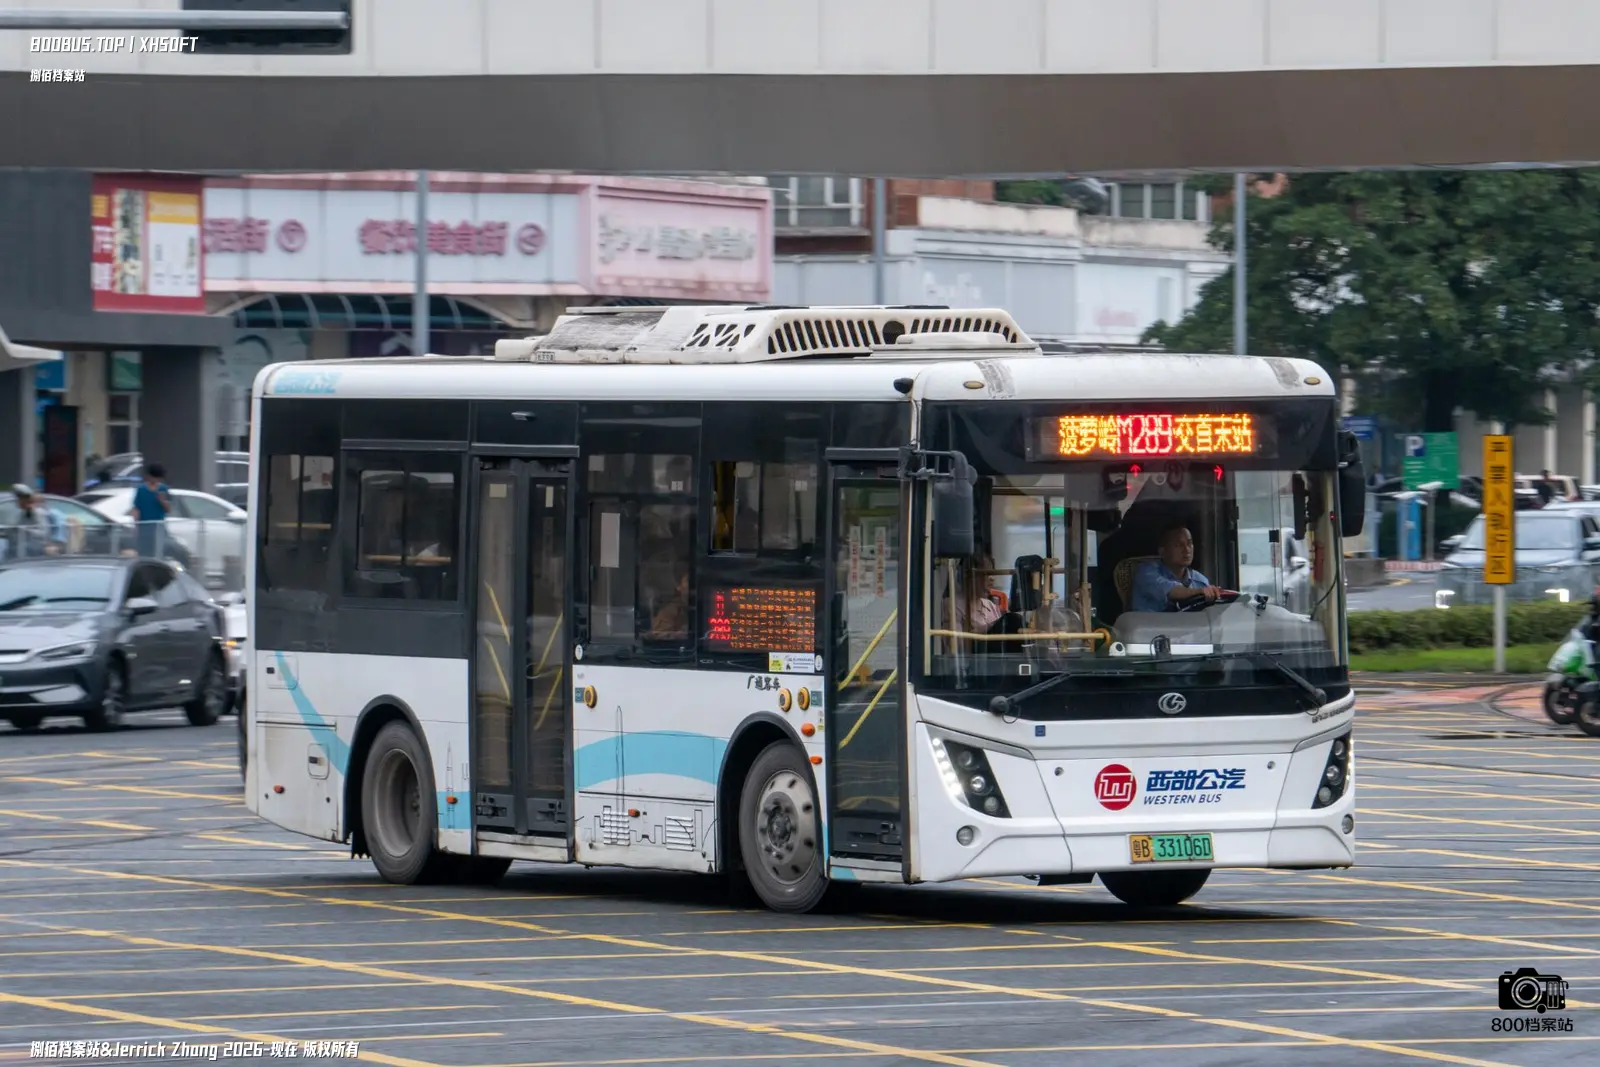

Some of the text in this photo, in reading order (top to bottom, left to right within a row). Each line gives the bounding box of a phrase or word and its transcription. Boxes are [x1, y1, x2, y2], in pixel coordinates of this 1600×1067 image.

[746, 674, 781, 691] 广通客车
[1146, 768, 1247, 792] 西部公汽
[1143, 793, 1223, 806] WESTERN BUS
